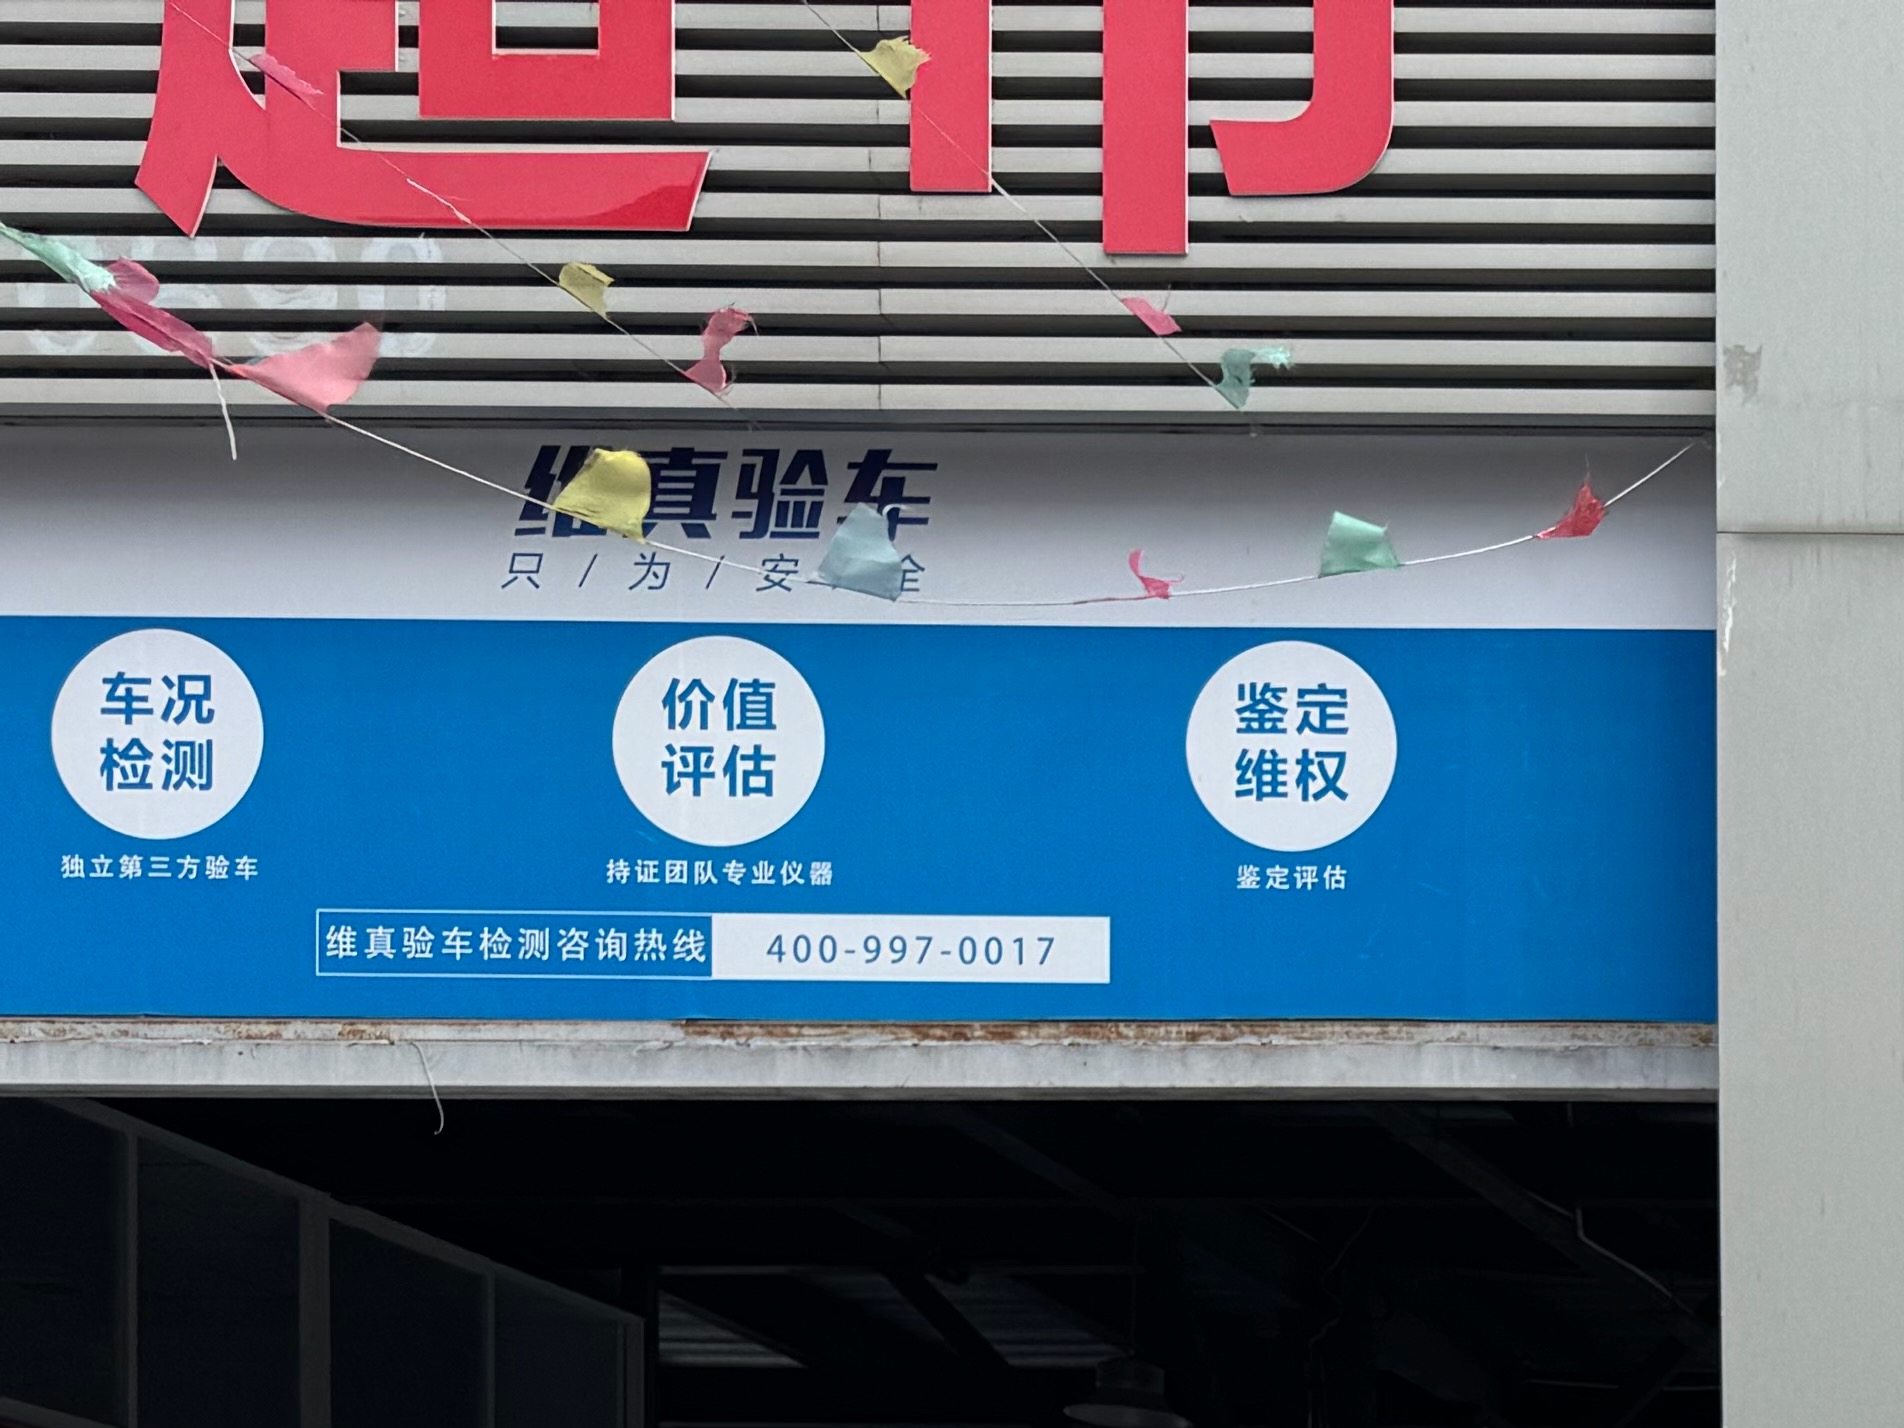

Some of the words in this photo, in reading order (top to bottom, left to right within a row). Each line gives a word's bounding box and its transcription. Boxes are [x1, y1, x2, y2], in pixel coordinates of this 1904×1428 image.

[100, 673, 215, 726] 车况
[661, 678, 777, 731] 价值
[1235, 683, 1349, 736] 鉴定
[100, 738, 213, 792] 检测
[661, 744, 776, 797] 评估
[1234, 749, 1350, 802] 维权
[60, 854, 260, 881] 独立第三方验车
[605, 859, 834, 886] 持证团队专业仪器
[1236, 865, 1347, 890] 鉴定评估
[325, 925, 706, 963] 维真验车检测咨询热线
[766, 932, 1056, 966] 400-997-0017
